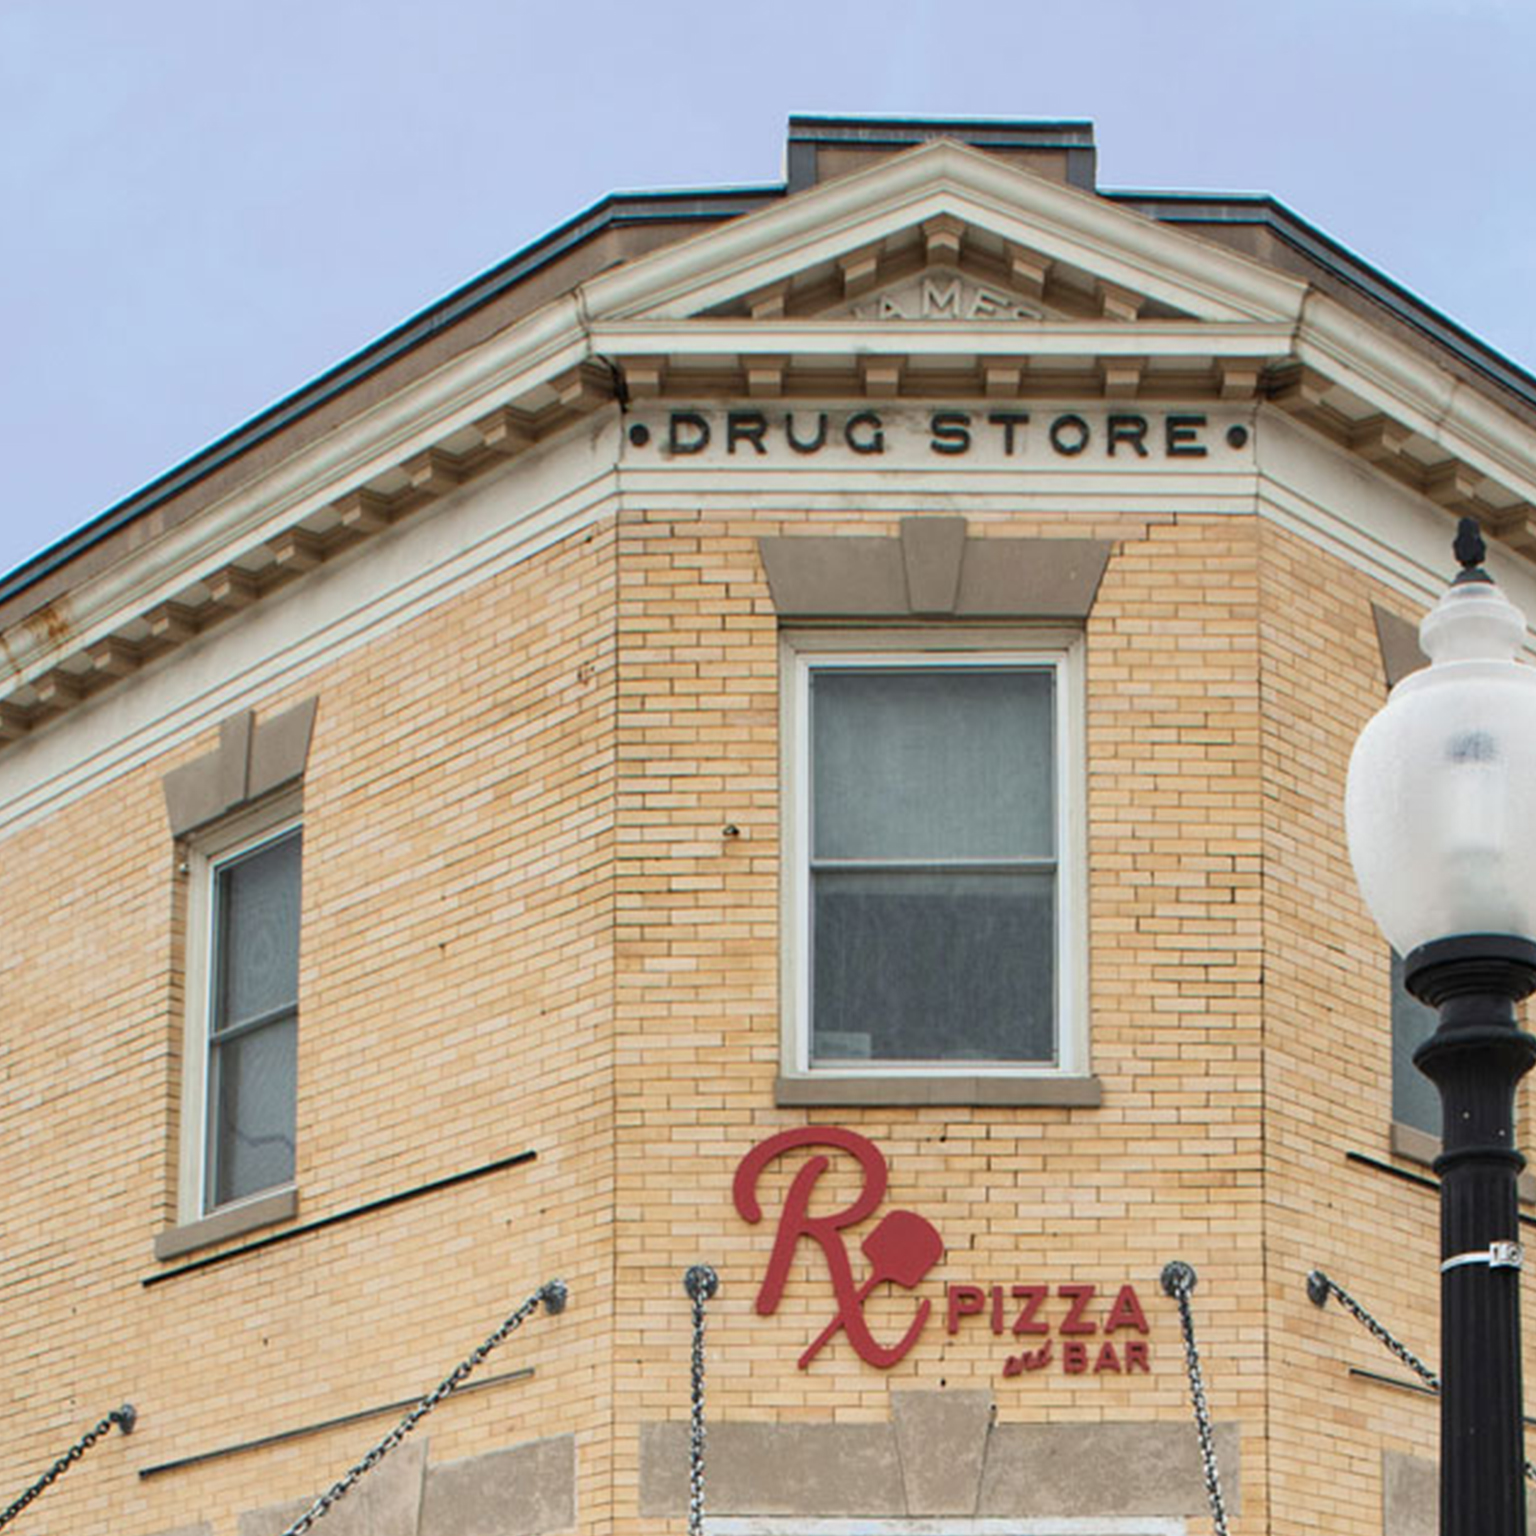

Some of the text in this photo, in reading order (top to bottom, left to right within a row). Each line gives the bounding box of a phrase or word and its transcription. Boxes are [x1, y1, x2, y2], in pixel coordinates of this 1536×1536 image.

[667, 413, 1208, 456] DRUG STORE
[947, 1284, 1151, 1336] PIZZA
[1002, 1339, 1152, 1379] and BAR
